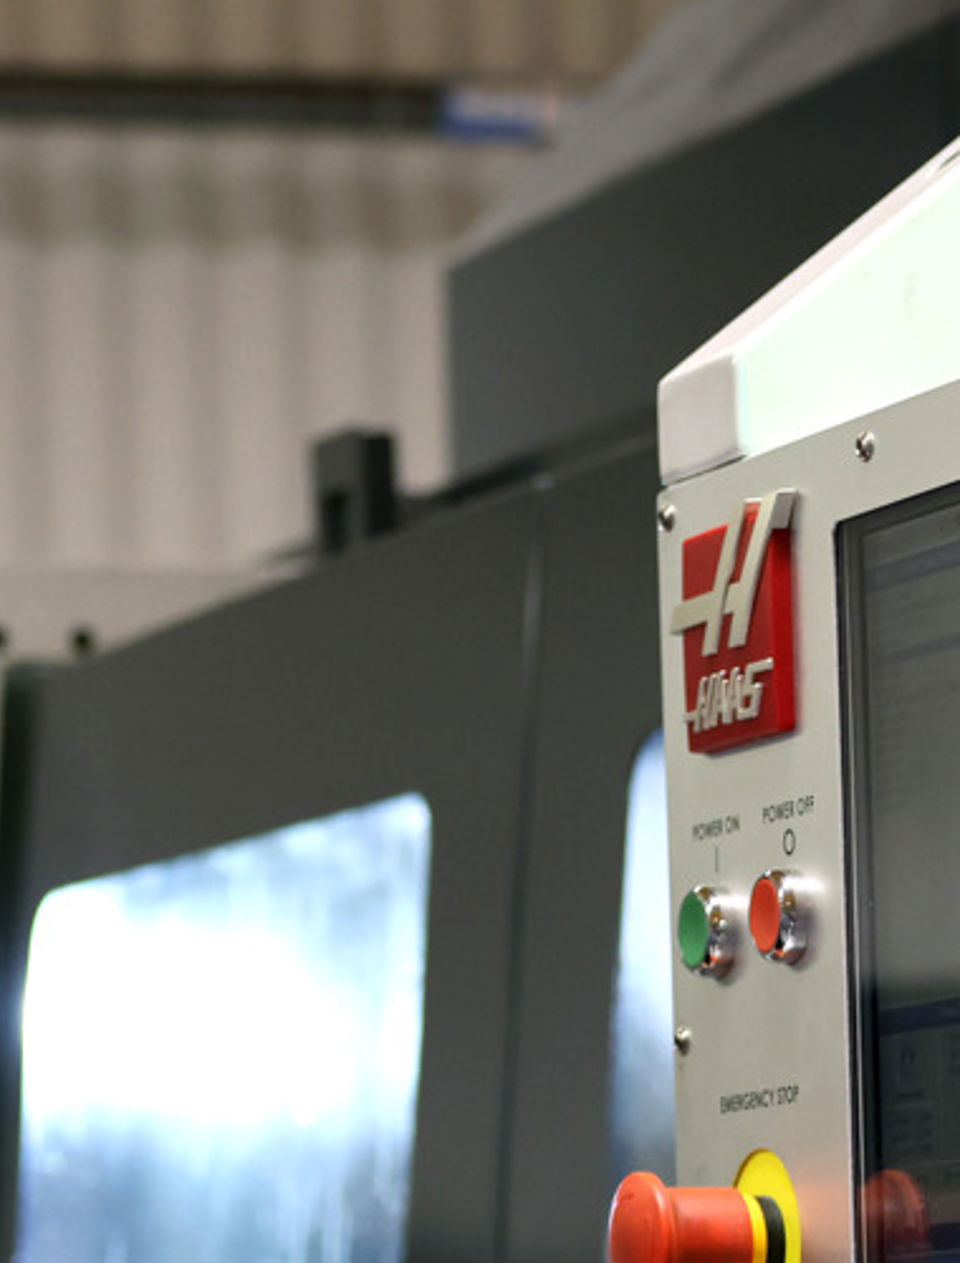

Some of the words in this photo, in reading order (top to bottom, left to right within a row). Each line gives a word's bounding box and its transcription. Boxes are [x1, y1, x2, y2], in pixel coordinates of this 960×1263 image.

[762, 800, 794, 823] POWER
[796, 795, 814, 816] OFF
[692, 819, 723, 841] POWER
[725, 814, 740, 834] ON
[720, 1089, 774, 1114] EMERGENCY
[777, 1085, 799, 1105] STOP
